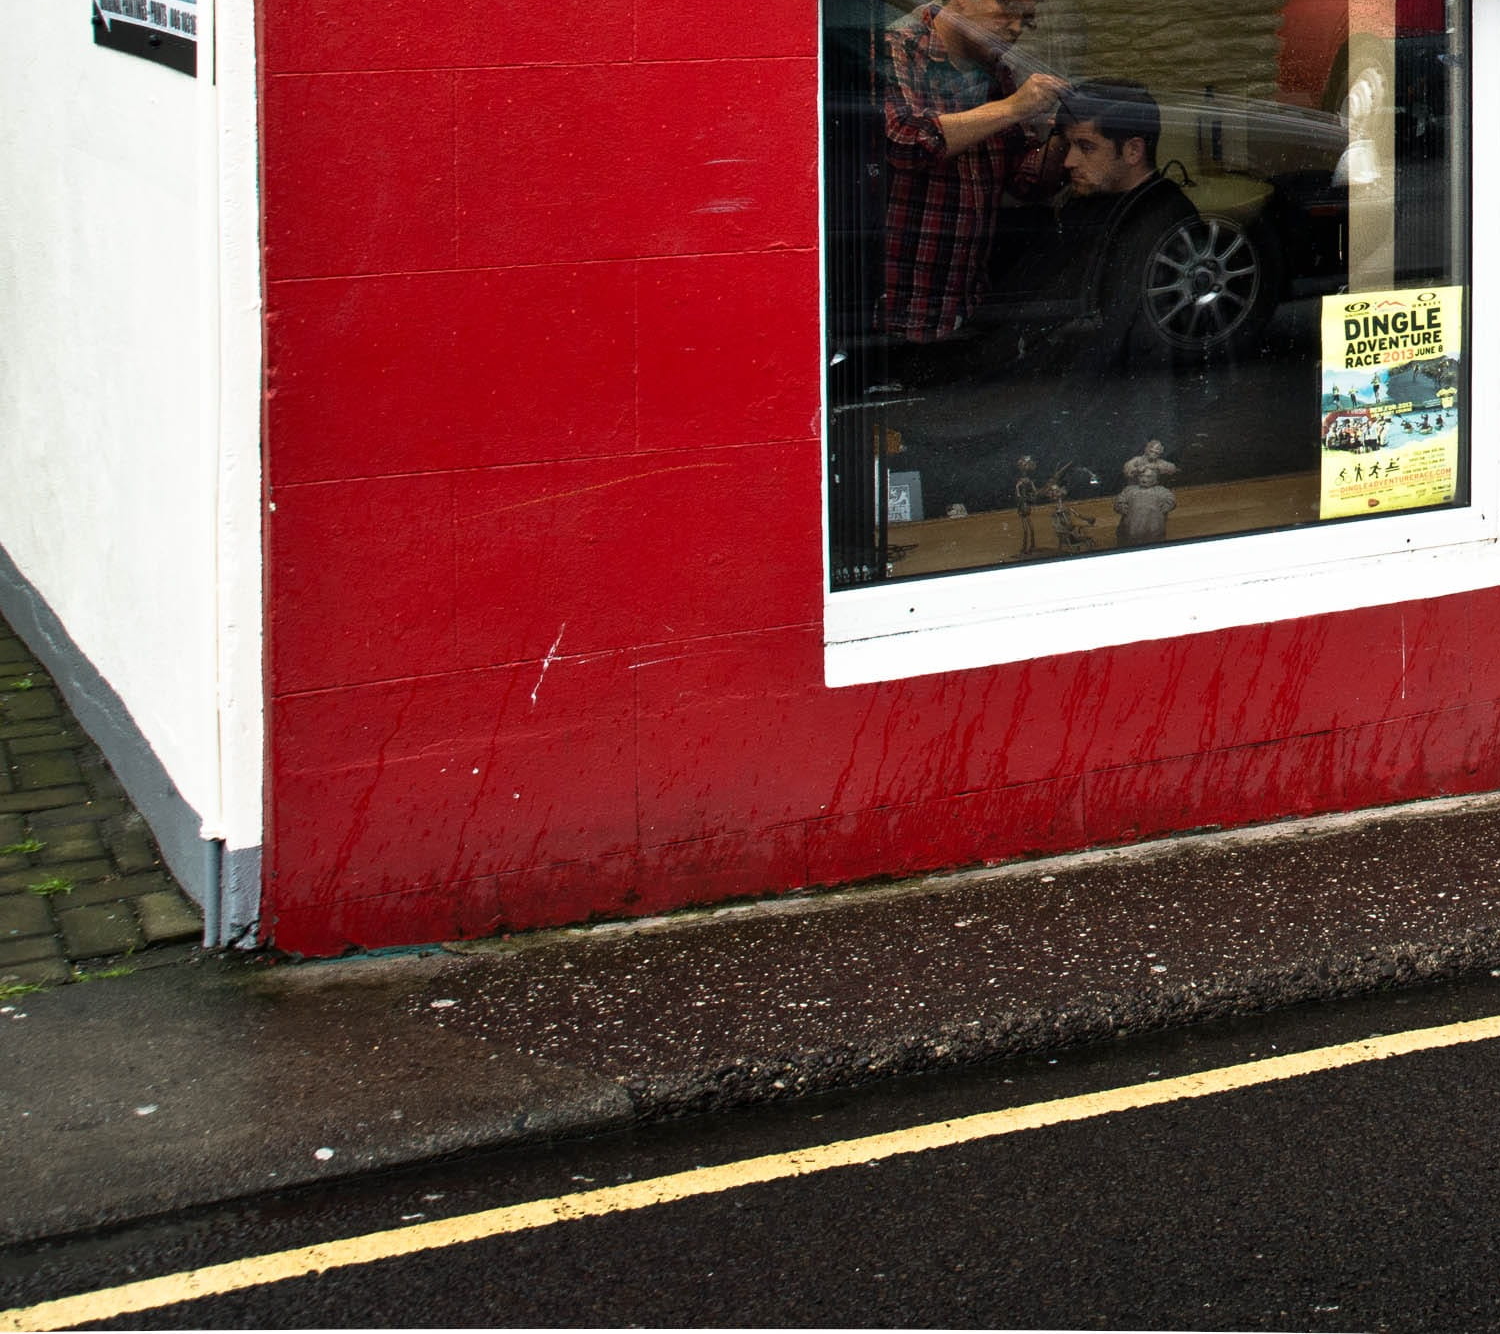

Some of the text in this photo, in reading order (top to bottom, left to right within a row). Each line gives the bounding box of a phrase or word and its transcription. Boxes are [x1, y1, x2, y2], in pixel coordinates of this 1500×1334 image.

[1344, 307, 1441, 341] DINGLE
[1345, 330, 1442, 356] ADVENTURE
[1345, 344, 1444, 369] RACE 2013 JUNE 8
